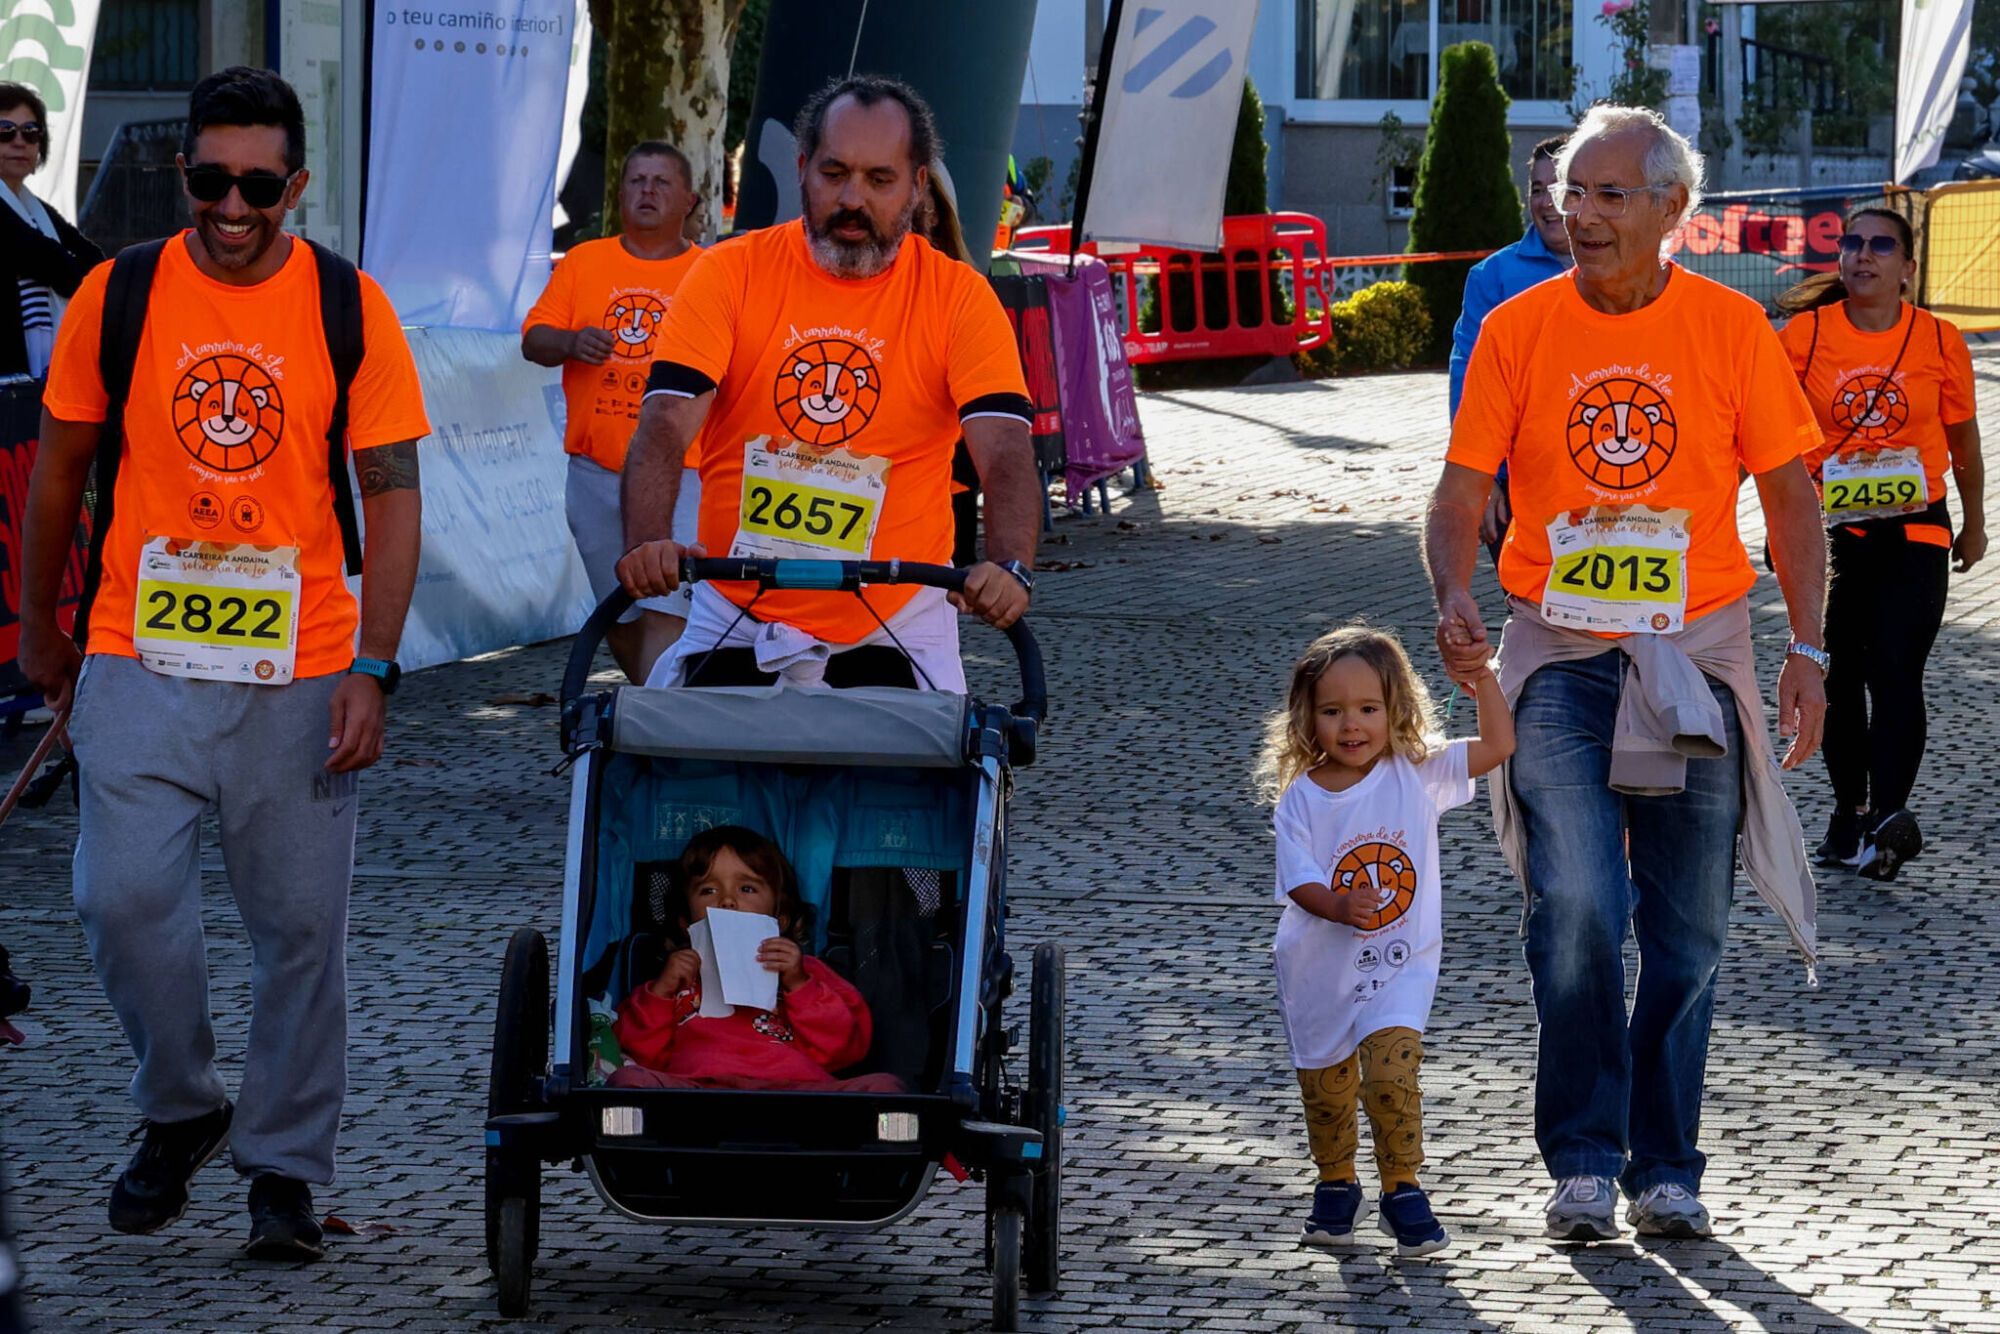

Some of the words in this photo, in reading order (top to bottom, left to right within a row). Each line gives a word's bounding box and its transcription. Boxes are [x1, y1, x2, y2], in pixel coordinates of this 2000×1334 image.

[403, 8, 433, 26] teu
[438, 10, 506, 32] camiño
[1585, 363, 1634, 383] carreira
[1831, 481, 1916, 509] 2459
[749, 486, 865, 540] 2657
[182, 551, 222, 561] CARREIRA
[231, 555, 270, 564] ANDAINA
[1561, 554, 1670, 593] 2013
[146, 590, 282, 639] 2822
